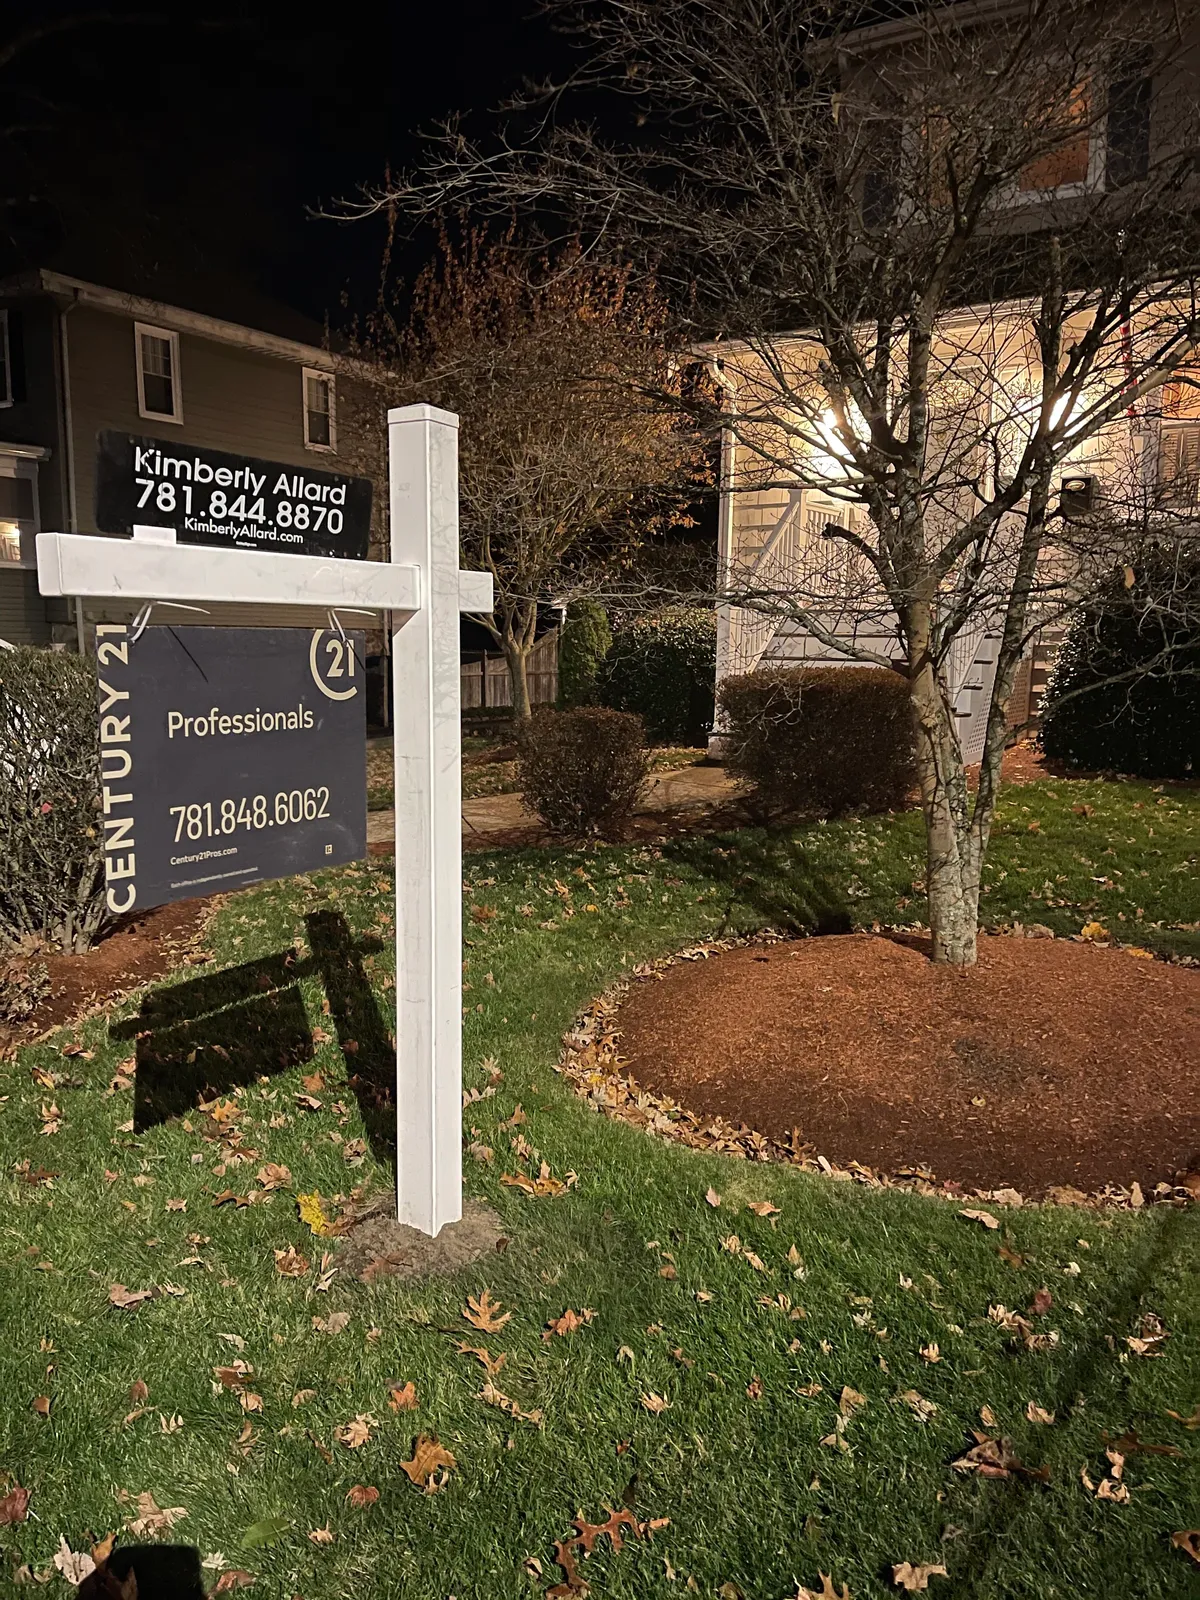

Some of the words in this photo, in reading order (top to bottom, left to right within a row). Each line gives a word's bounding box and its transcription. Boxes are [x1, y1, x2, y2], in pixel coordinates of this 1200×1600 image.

[135, 446, 266, 496] Kimberly
[272, 473, 346, 505] Allard
[135, 478, 344, 534] 781.844.8870
[184, 517, 304, 544] KimberlyAllard.com
[96, 624, 129, 665] 21
[168, 703, 314, 739] Professionals
[98, 678, 136, 914] CENTURY
[169, 786, 330, 843] 781.848.6062
[170, 846, 238, 866] Century21Pros.com
